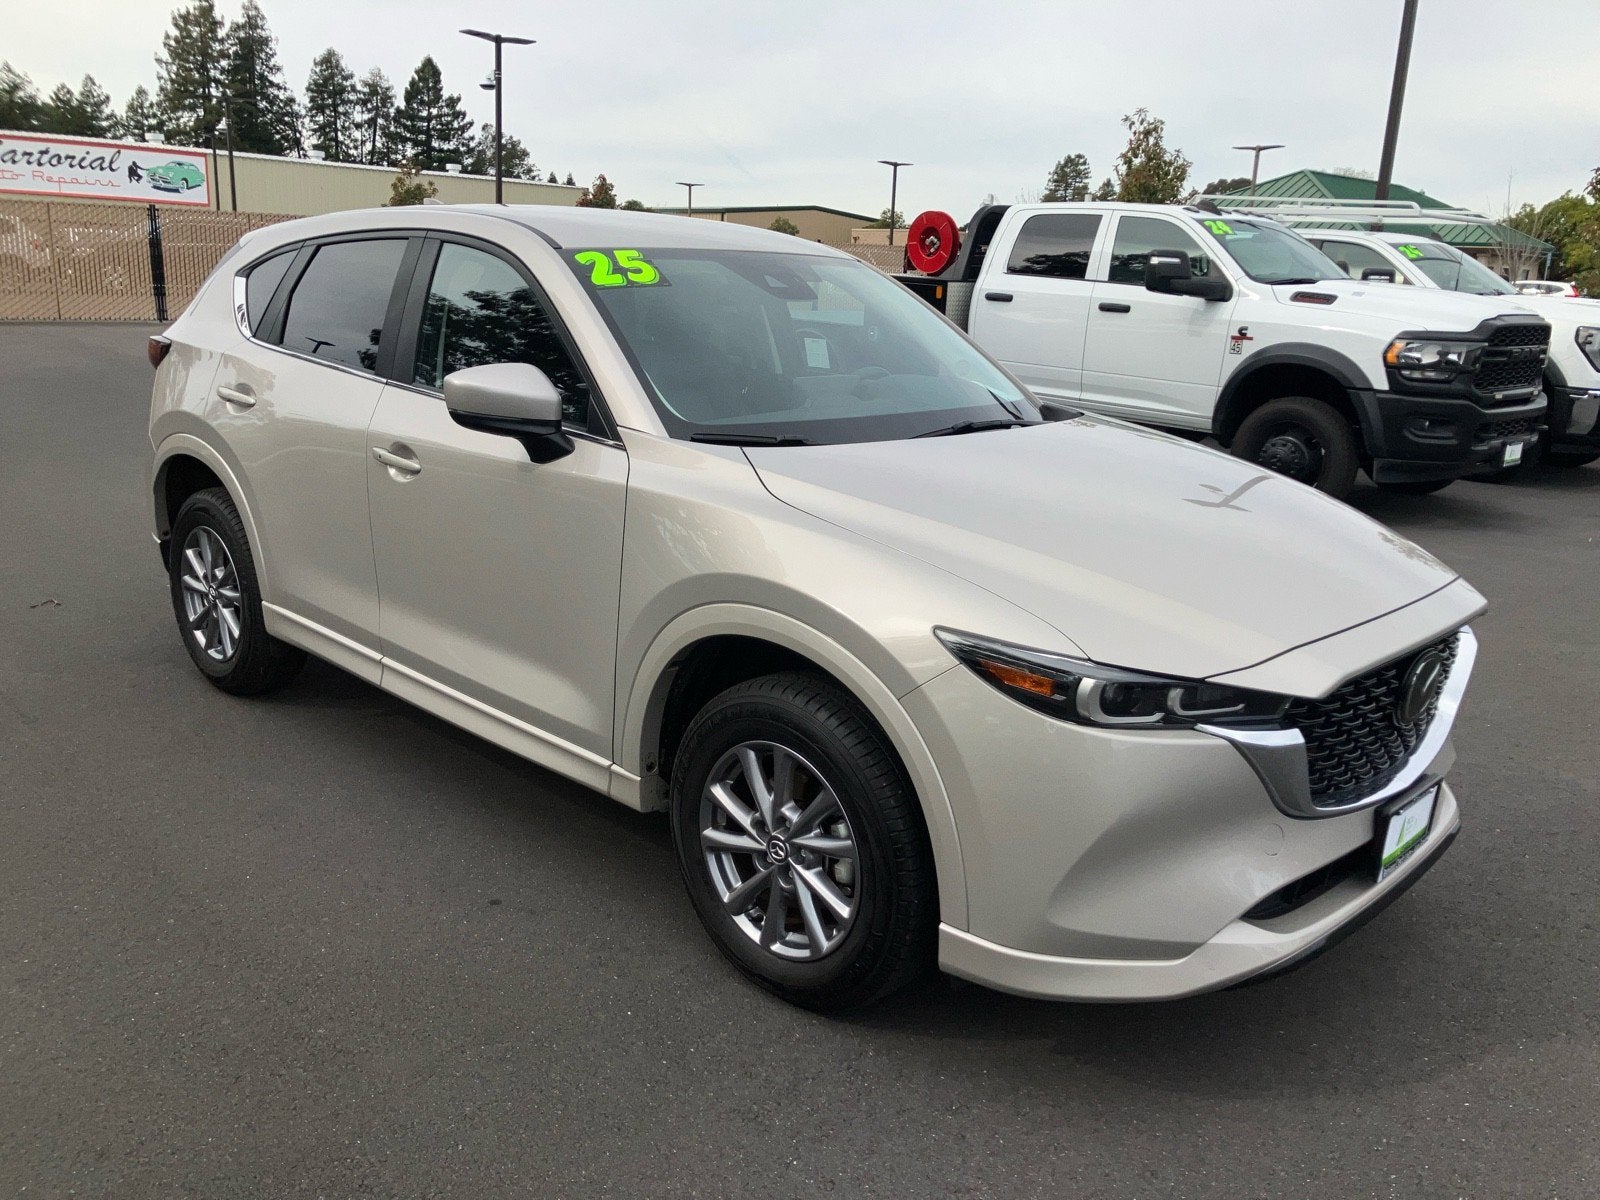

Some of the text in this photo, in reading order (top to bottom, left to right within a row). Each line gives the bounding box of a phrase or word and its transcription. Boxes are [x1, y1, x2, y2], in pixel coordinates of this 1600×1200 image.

[0, 140, 122, 172] artorial
[32, 170, 121, 192] Repairs
[574, 250, 660, 287] 25
